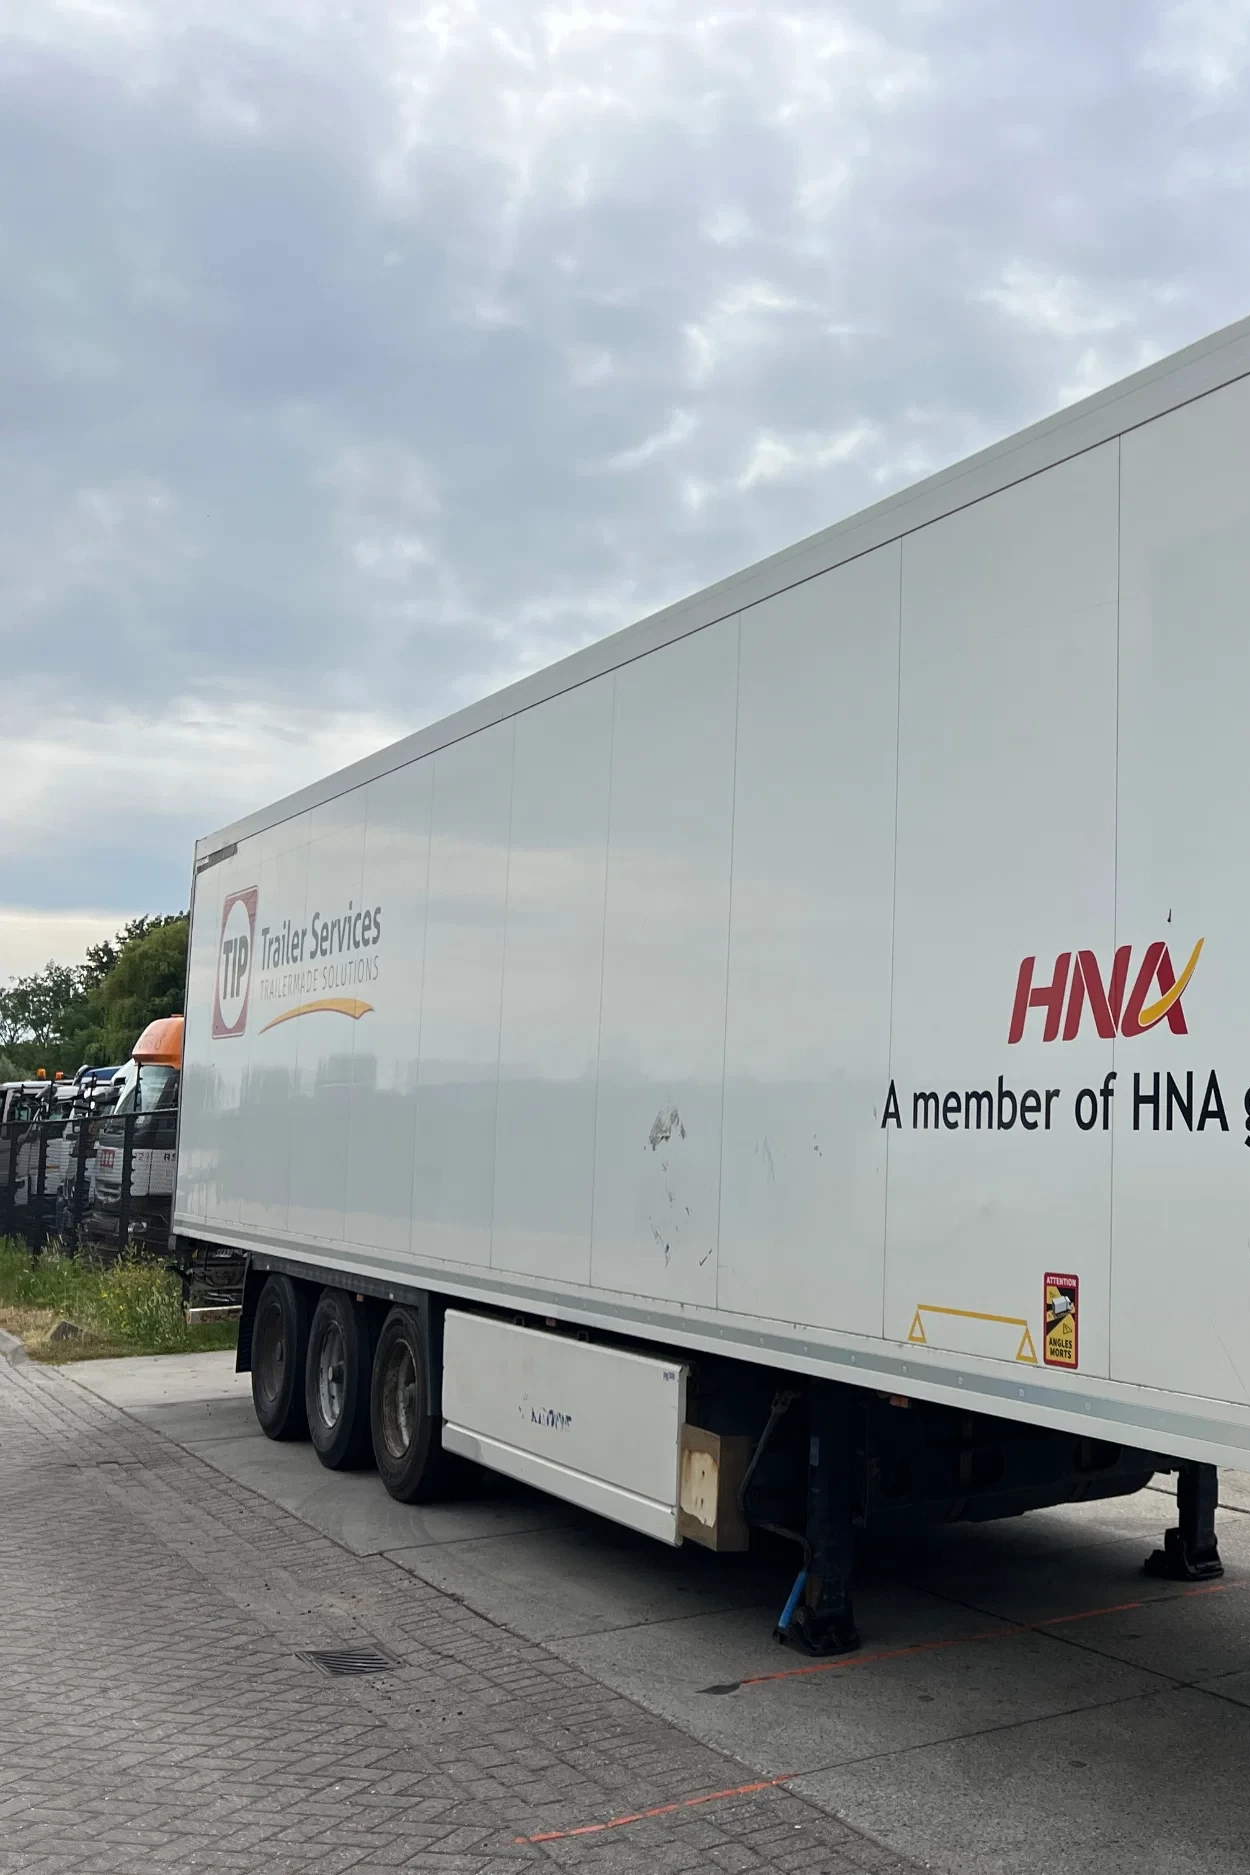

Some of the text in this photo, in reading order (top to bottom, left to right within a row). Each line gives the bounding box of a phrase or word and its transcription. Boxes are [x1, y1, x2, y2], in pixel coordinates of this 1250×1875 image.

[261, 900, 382, 971] Trailer Services
[222, 934, 249, 1000] TIP
[260, 955, 379, 1001] TRAILERMADE SOLUTIONS
[1008, 938, 1204, 1044] HNA
[881, 1079, 903, 1129] A
[912, 1074, 1060, 1130] member
[1074, 1071, 1118, 1130] of
[1132, 1069, 1229, 1131] HNA
[1046, 1276, 1077, 1287] ATTENTION
[1049, 1337, 1073, 1349] ANGLES
[1050, 1347, 1072, 1359] MORTS
